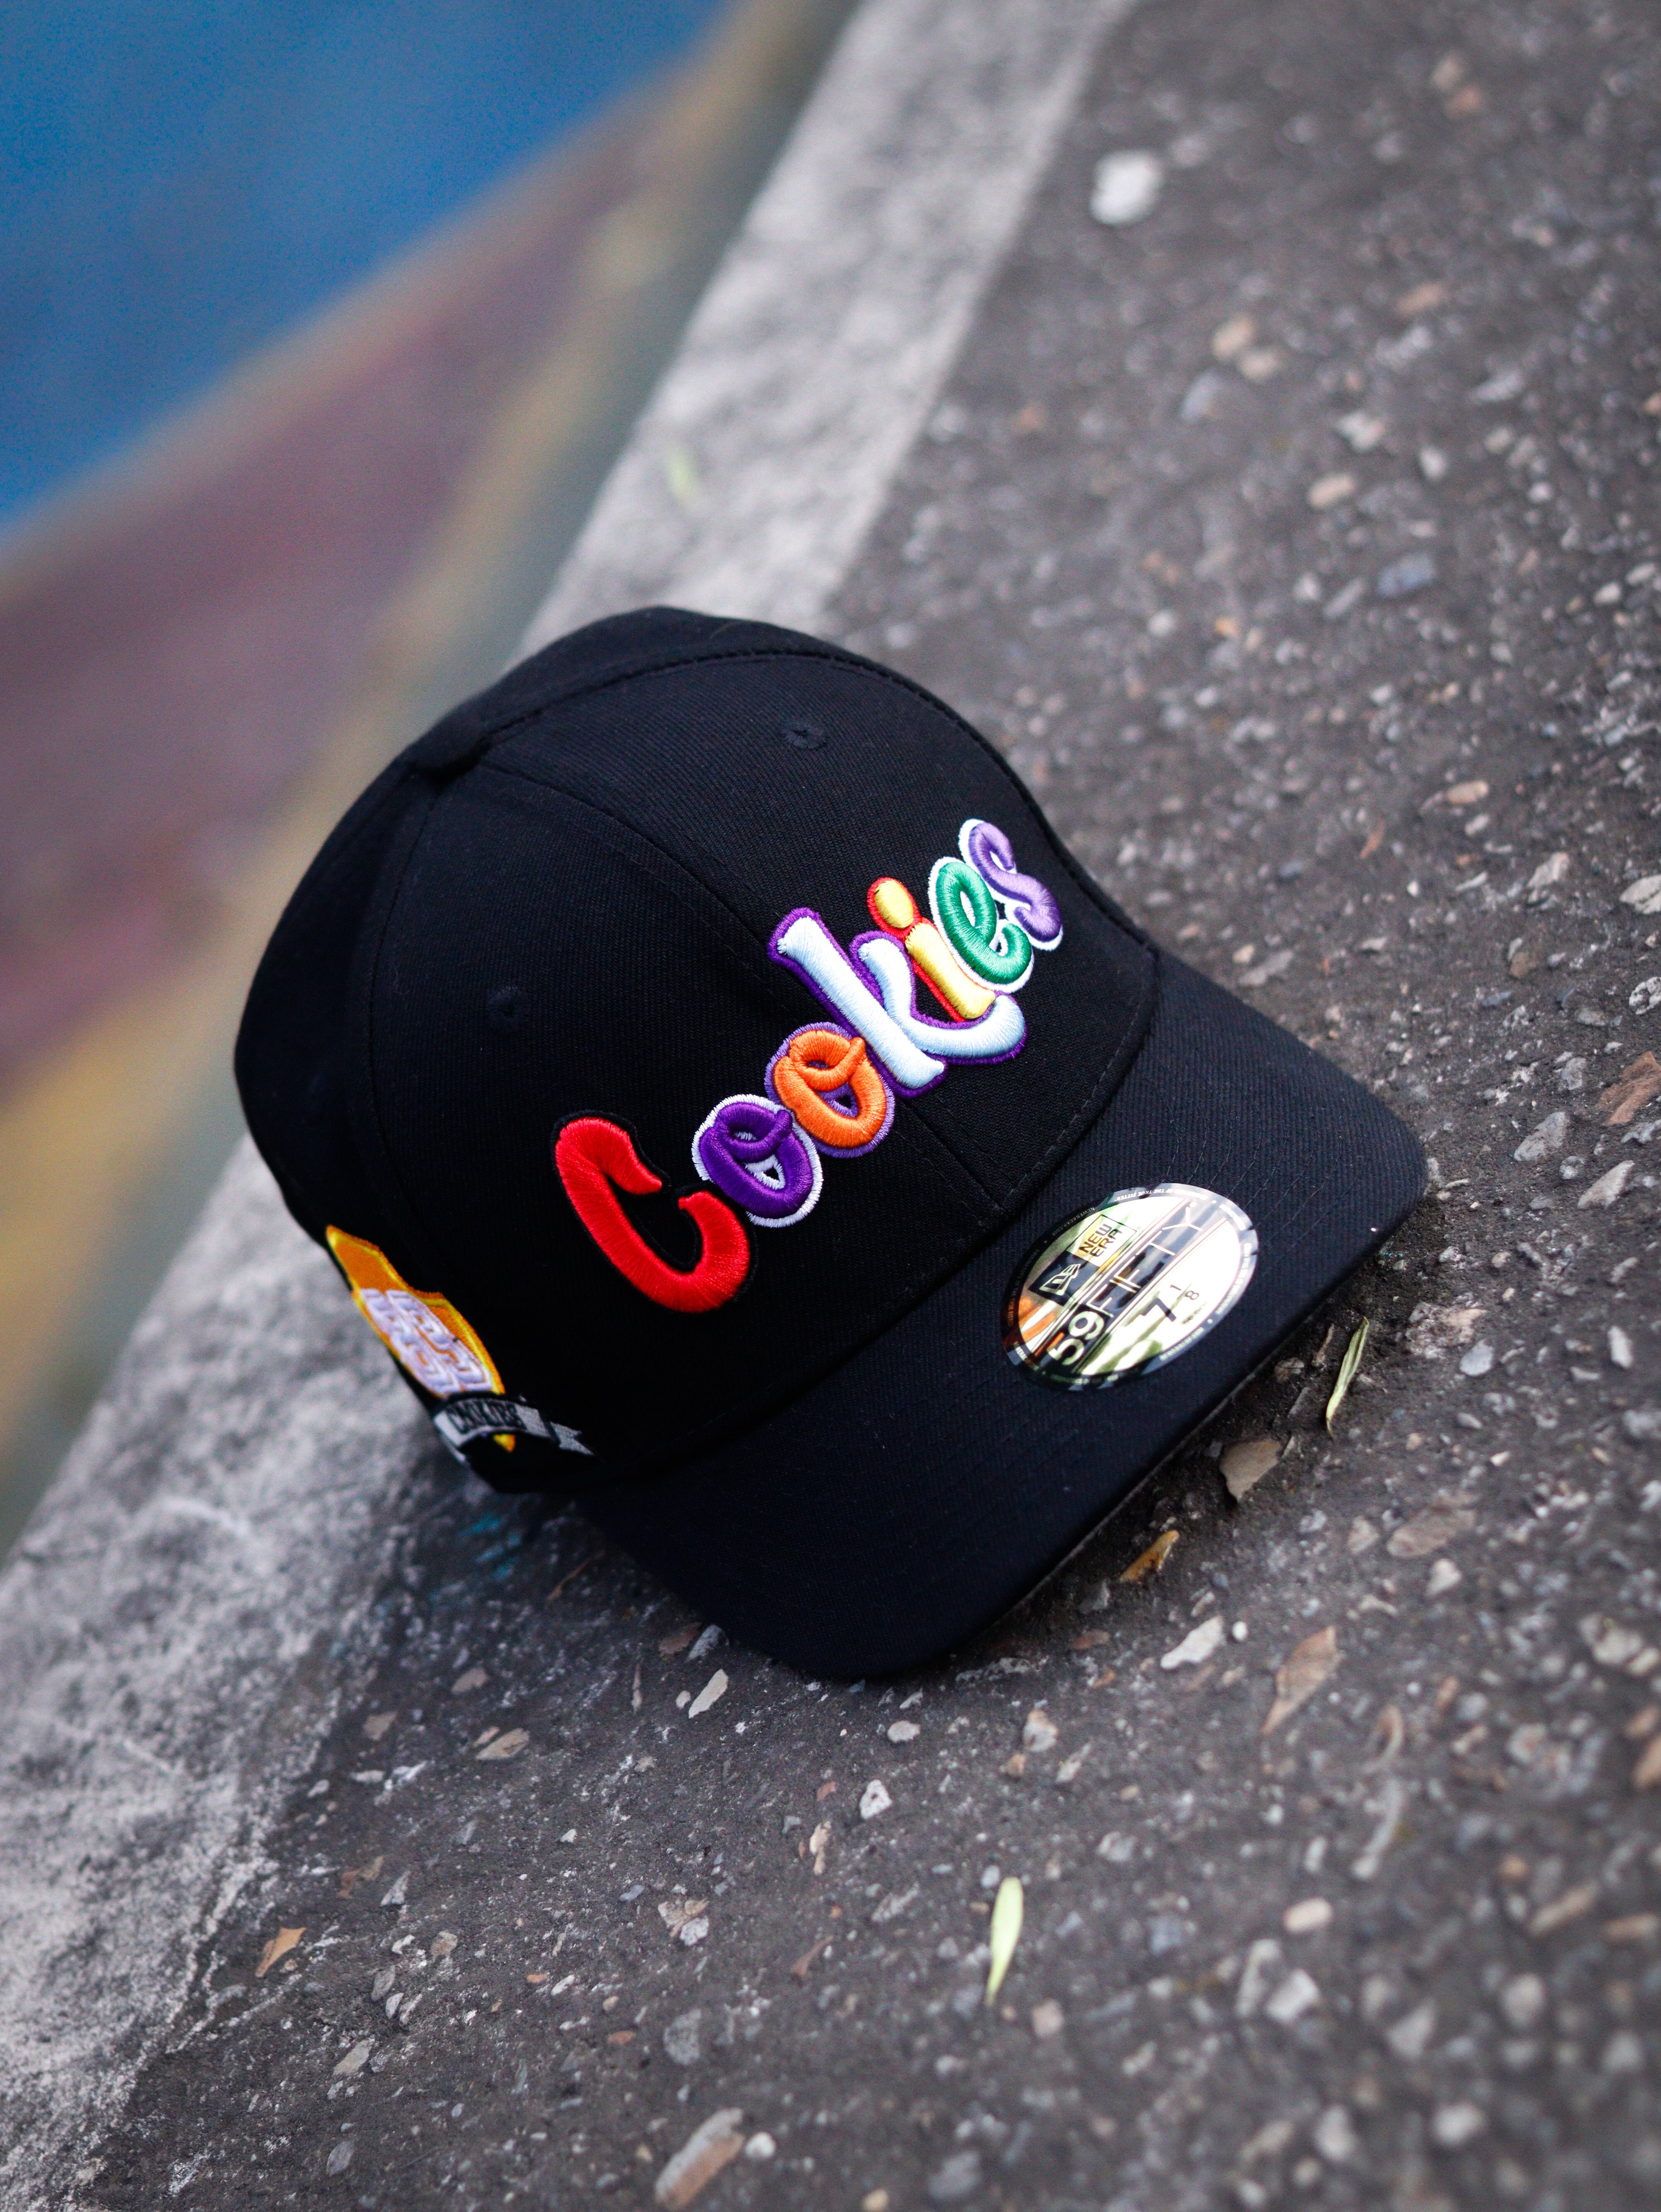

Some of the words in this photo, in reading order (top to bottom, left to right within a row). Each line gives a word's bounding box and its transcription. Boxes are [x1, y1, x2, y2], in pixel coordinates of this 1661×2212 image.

[555, 819, 1063, 1313] Cookies
[1079, 1223, 1113, 1253] NEW
[1090, 1230, 1124, 1257] ERA
[1141, 1296, 1177, 1322] 7
